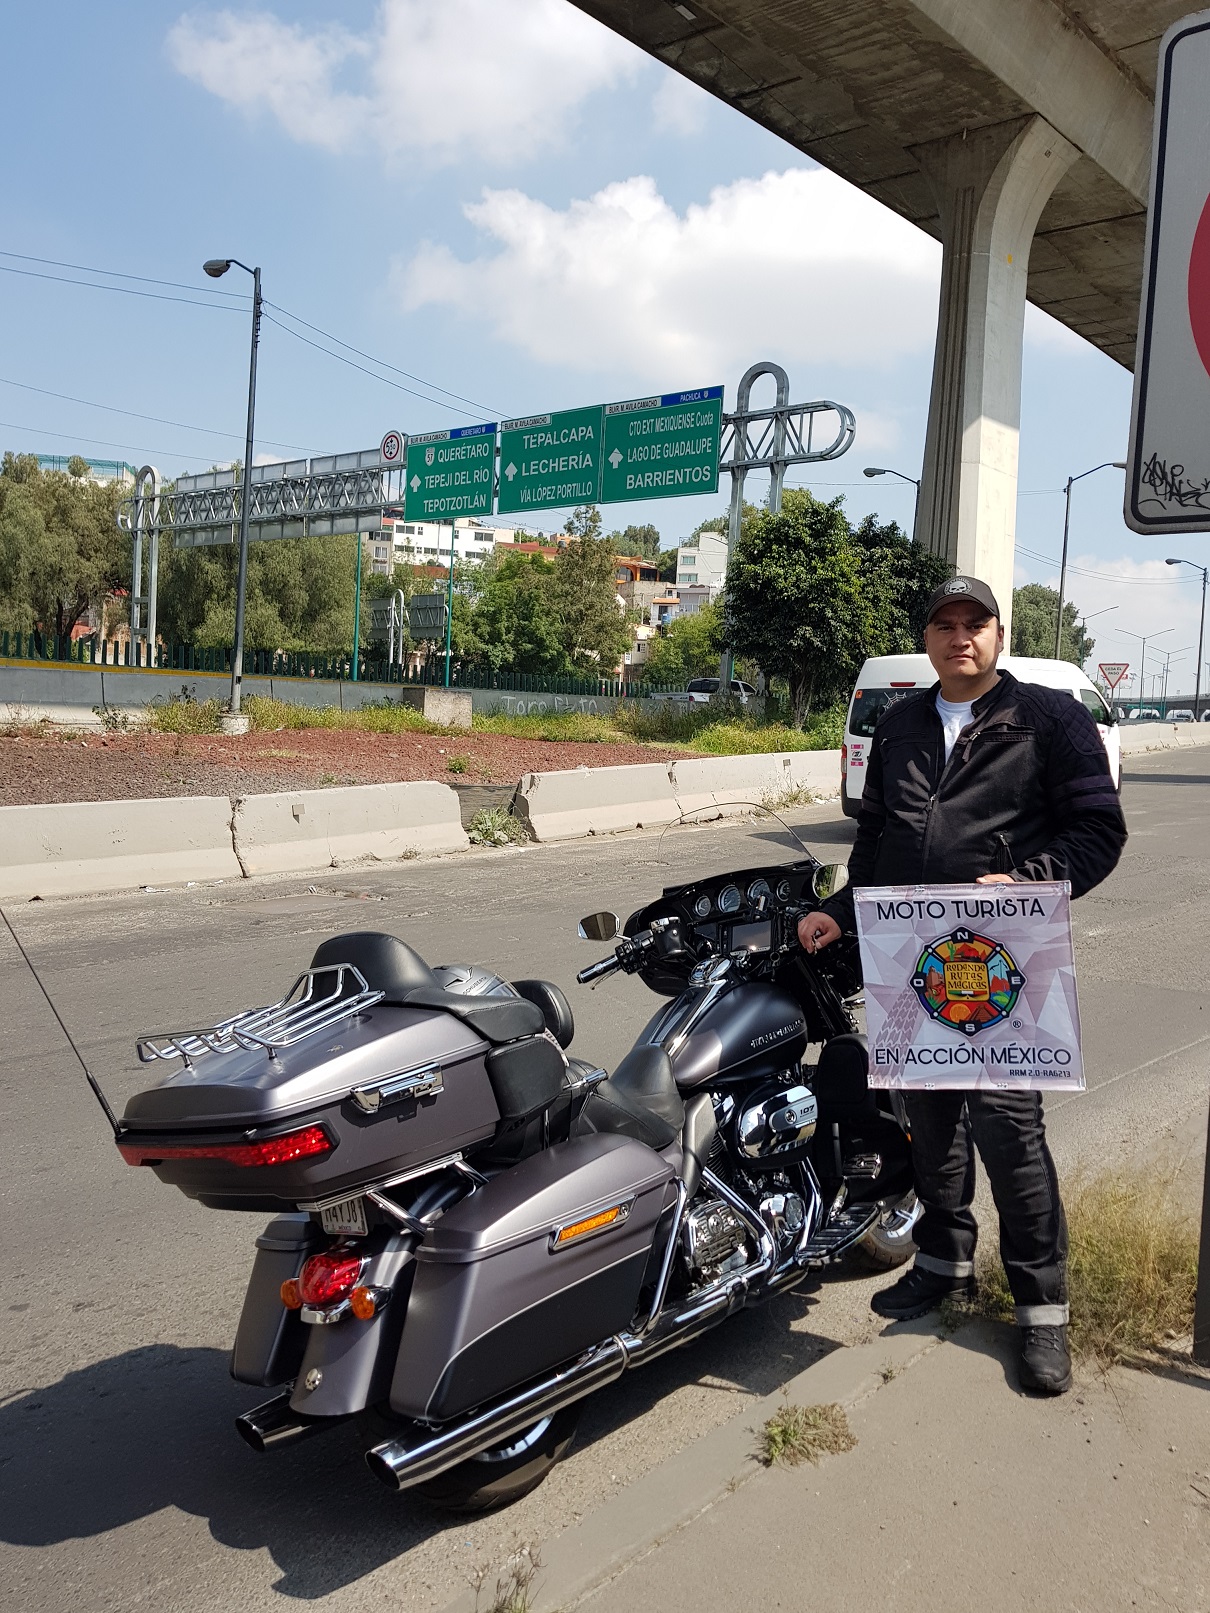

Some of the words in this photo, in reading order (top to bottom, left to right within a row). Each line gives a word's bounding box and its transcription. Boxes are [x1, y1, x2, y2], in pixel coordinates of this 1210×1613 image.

[679, 392, 701, 402] PACHUCA
[629, 420, 641, 436] CTO
[641, 418, 654, 435] EXT
[655, 412, 695, 433] MEXIQUENSE
[695, 411, 714, 427] Cuota
[522, 425, 594, 450] TEPALCAPA
[426, 453, 433, 463] 57
[437, 442, 489, 463] QUERÉTARO
[627, 446, 649, 463] LAGO
[650, 444, 661, 460] DE
[662, 437, 713, 458] GUADALUPE
[521, 450, 593, 477] LECHERÍA
[424, 472, 452, 489] TEPEJI
[454, 470, 471, 486] DEL
[473, 465, 490, 483] RÍO
[626, 465, 711, 490] BARRIENTOS
[423, 490, 487, 513] TEPOTZOTLÁN
[520, 485, 531, 503] VÍA
[532, 483, 556, 502] LÓPEZ
[556, 481, 593, 500] PORTILLO
[876, 900, 946, 921] MOTO
[951, 897, 1046, 919] TURISTA
[956, 931, 969, 940] N
[1010, 976, 1022, 984] E
[964, 1023, 976, 1032] S
[875, 1048, 899, 1065] EN
[904, 1042, 985, 1065] ACCIÓN
[990, 1042, 1072, 1066] MÉXICO
[1009, 1069, 1027, 1077] RRM
[799, 1103, 815, 1115] 107
